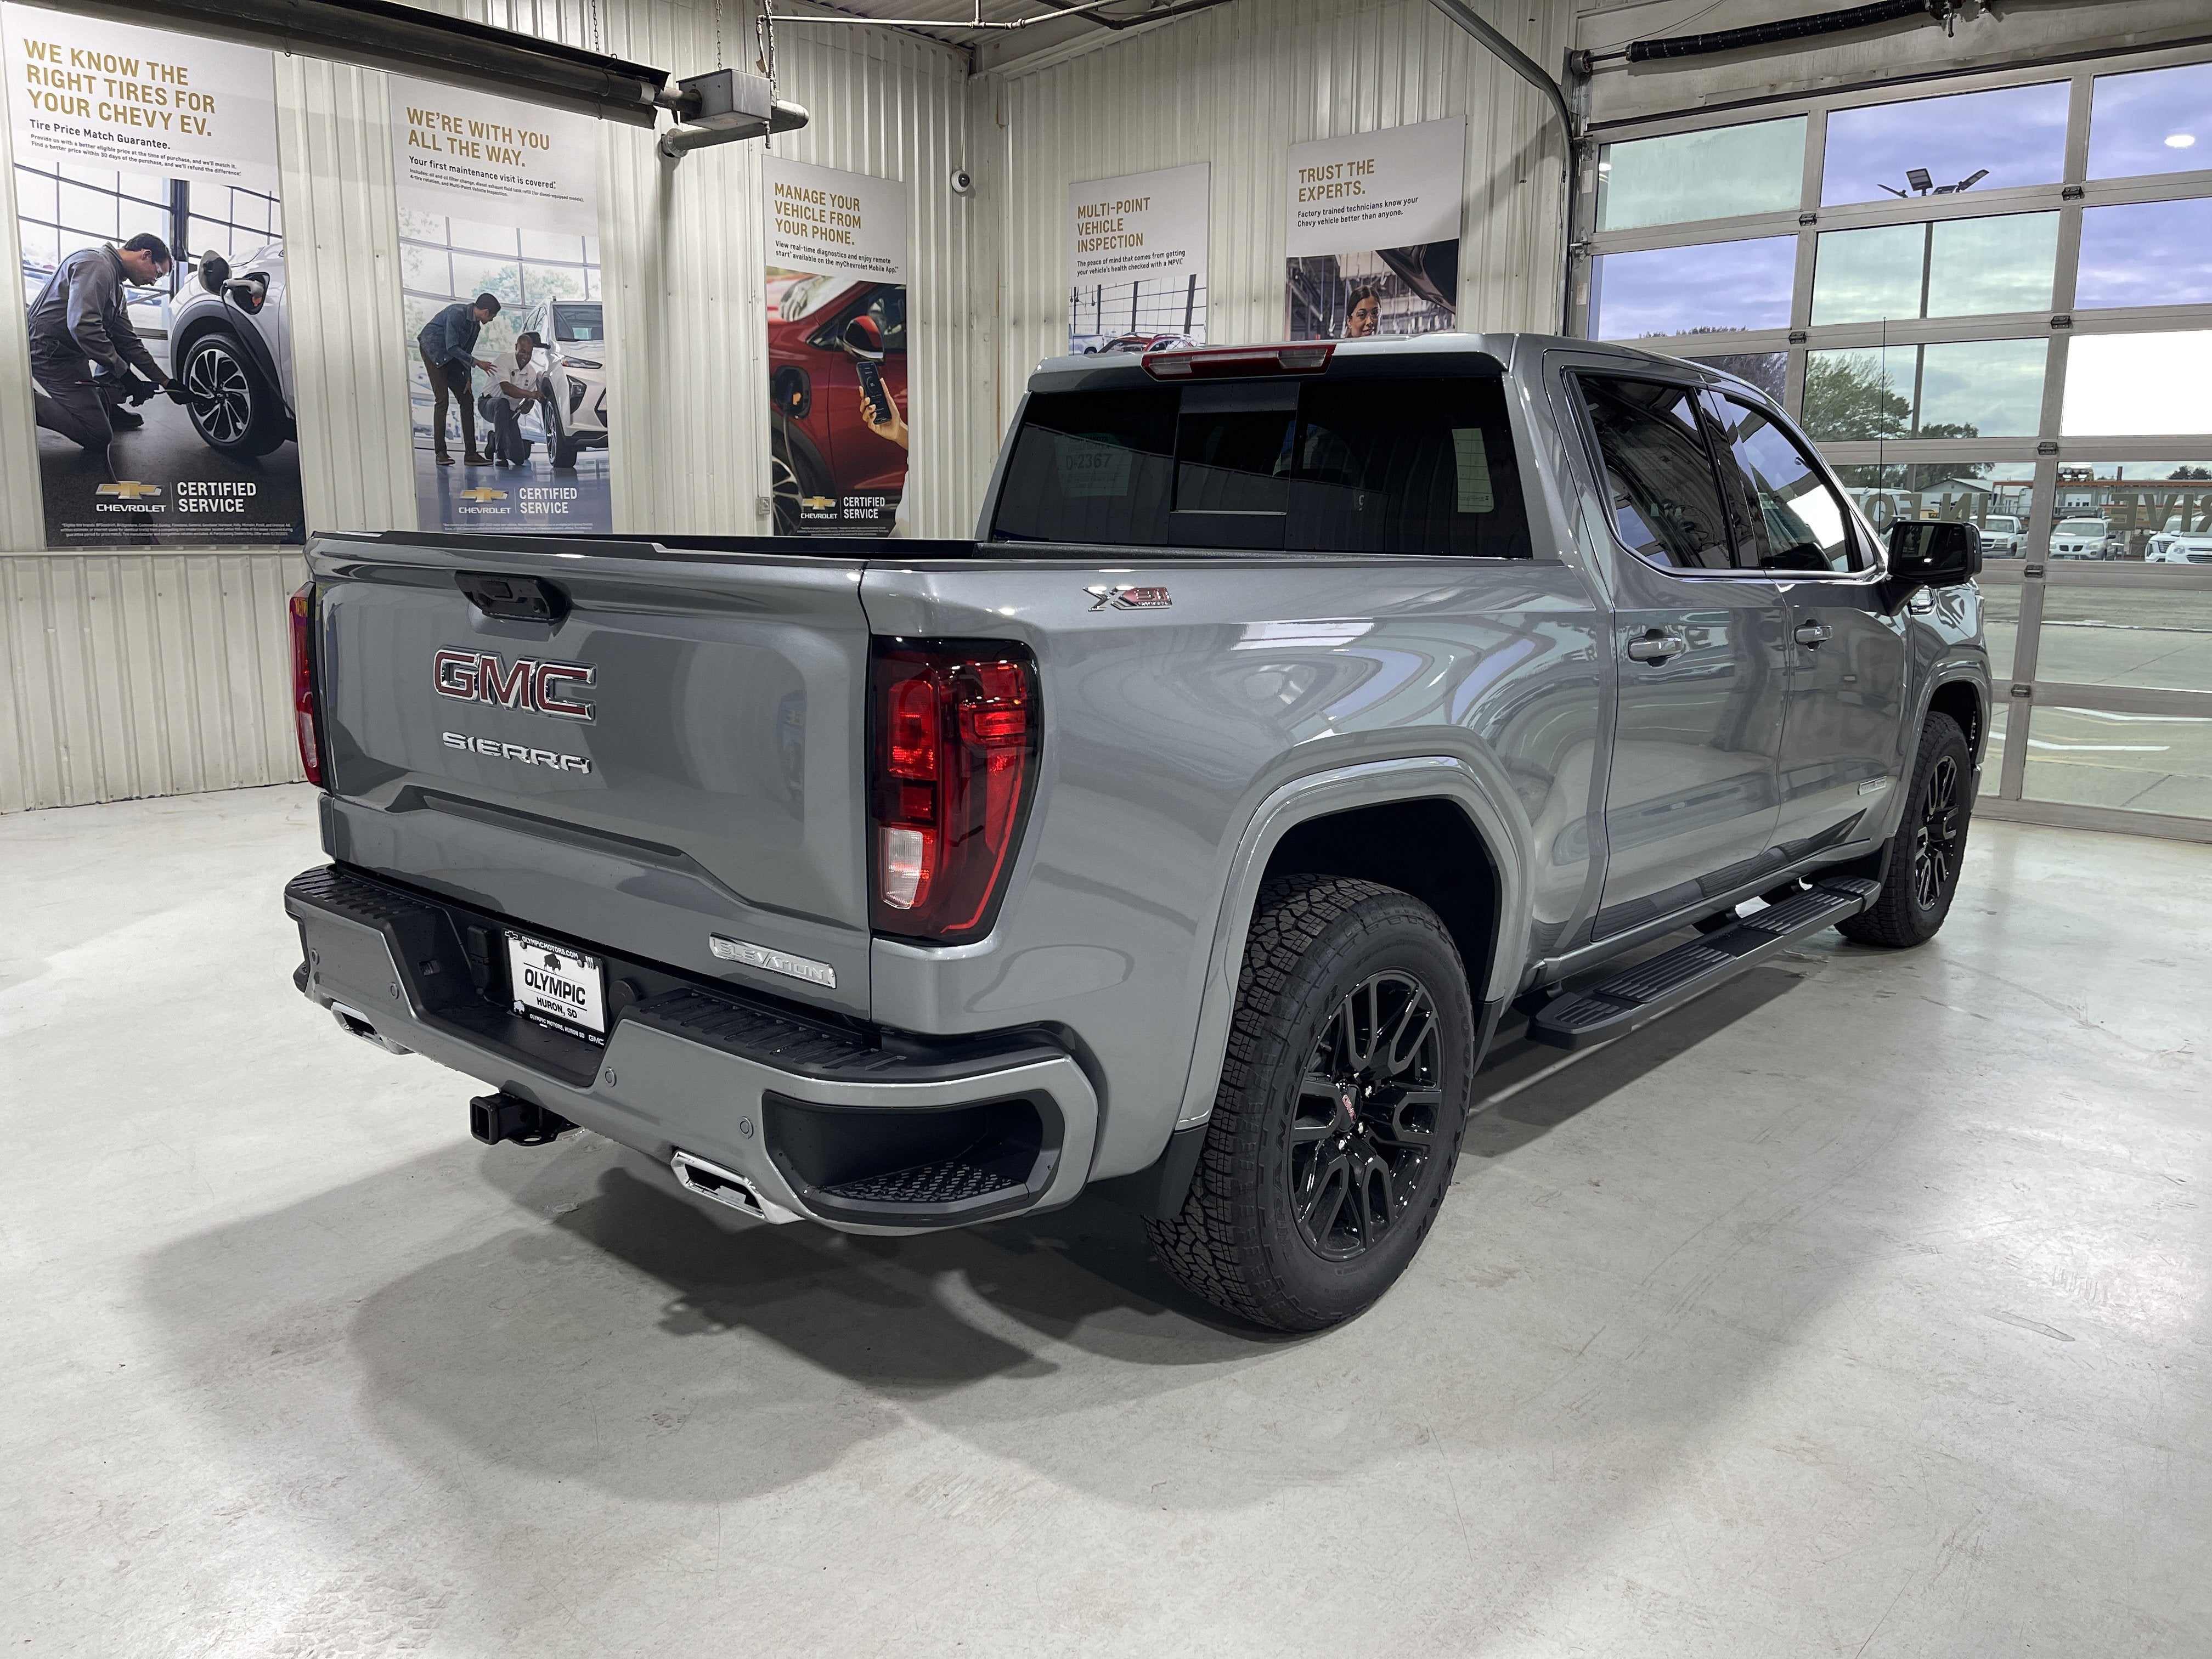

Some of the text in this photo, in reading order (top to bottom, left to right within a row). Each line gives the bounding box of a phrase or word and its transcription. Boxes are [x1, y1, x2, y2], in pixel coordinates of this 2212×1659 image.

[24, 38, 188, 86] WE KNOW THE
[27, 64, 216, 114] RIGHT TIRES FOR
[27, 88, 212, 137] YOUR CHEVY EV.
[30, 119, 171, 150] Tire Price Match Guarantee.
[31, 134, 52, 142] Provide
[406, 106, 550, 151] WE'RE WITH YOU
[408, 129, 526, 167] ALL THE WAY.
[409, 155, 427, 167] Your
[429, 160, 447, 171] first
[449, 165, 498, 180] maintenance
[499, 173, 516, 183] visit
[517, 176, 523, 184] is
[422, 177, 441, 185] rotation,
[1299, 159, 1375, 184] TRUST THE
[775, 182, 860, 212] MANAGE YOUR
[1299, 180, 1366, 202] EXPERTS.
[774, 200, 861, 229] VEHICLE FROM
[1077, 196, 1150, 219] MULTI-POINT
[1297, 208, 1321, 218] Factory
[1323, 206, 1345, 215] trained
[1346, 202, 1383, 213] technicians
[1403, 196, 1419, 206] your
[1077, 217, 1124, 236] VEHICLE
[1297, 210, 1403, 228] Chevy vehicle better than anyone.
[775, 218, 855, 246] YOUR PHONE.
[1077, 233, 1144, 253] INSPECTION
[775, 240, 789, 249] View
[790, 244, 816, 254] real-time
[817, 248, 847, 259] diagnostics
[858, 255, 872, 263] enjoy
[792, 252, 816, 263] available
[835, 260, 868, 270] myChevrolet
[868, 263, 884, 272] Mobile
[1087, 259, 1102, 269] peace
[1166, 250, 1186, 260] getting
[1090, 266, 1110, 274] vehicle's
[1111, 264, 1127, 272] health
[1150, 261, 1163, 269] with
[177, 482, 257, 497] CERTIFIED
[520, 488, 577, 500] CERTIFIED
[96, 504, 166, 512] CHEVROLET
[178, 499, 245, 513] SERVICE
[520, 502, 568, 514] SERVICE
[843, 496, 885, 507] CERTIFIED
[844, 509, 878, 519] SERVICE
[433, 646, 597, 723] GMC
[442, 731, 592, 774] SIERRA
[522, 936, 579, 960] OLYMPICMOTORS.COM
[720, 940, 824, 980] ELEVATION
[524, 968, 585, 1006] OLYMPIC
[537, 996, 577, 1019] HURON, SD
[530, 1014, 546, 1024] OLYMPIC
[547, 1020, 564, 1032] MOTORS,
[565, 1026, 579, 1037] HURON
[588, 1034, 605, 1046] GMC
